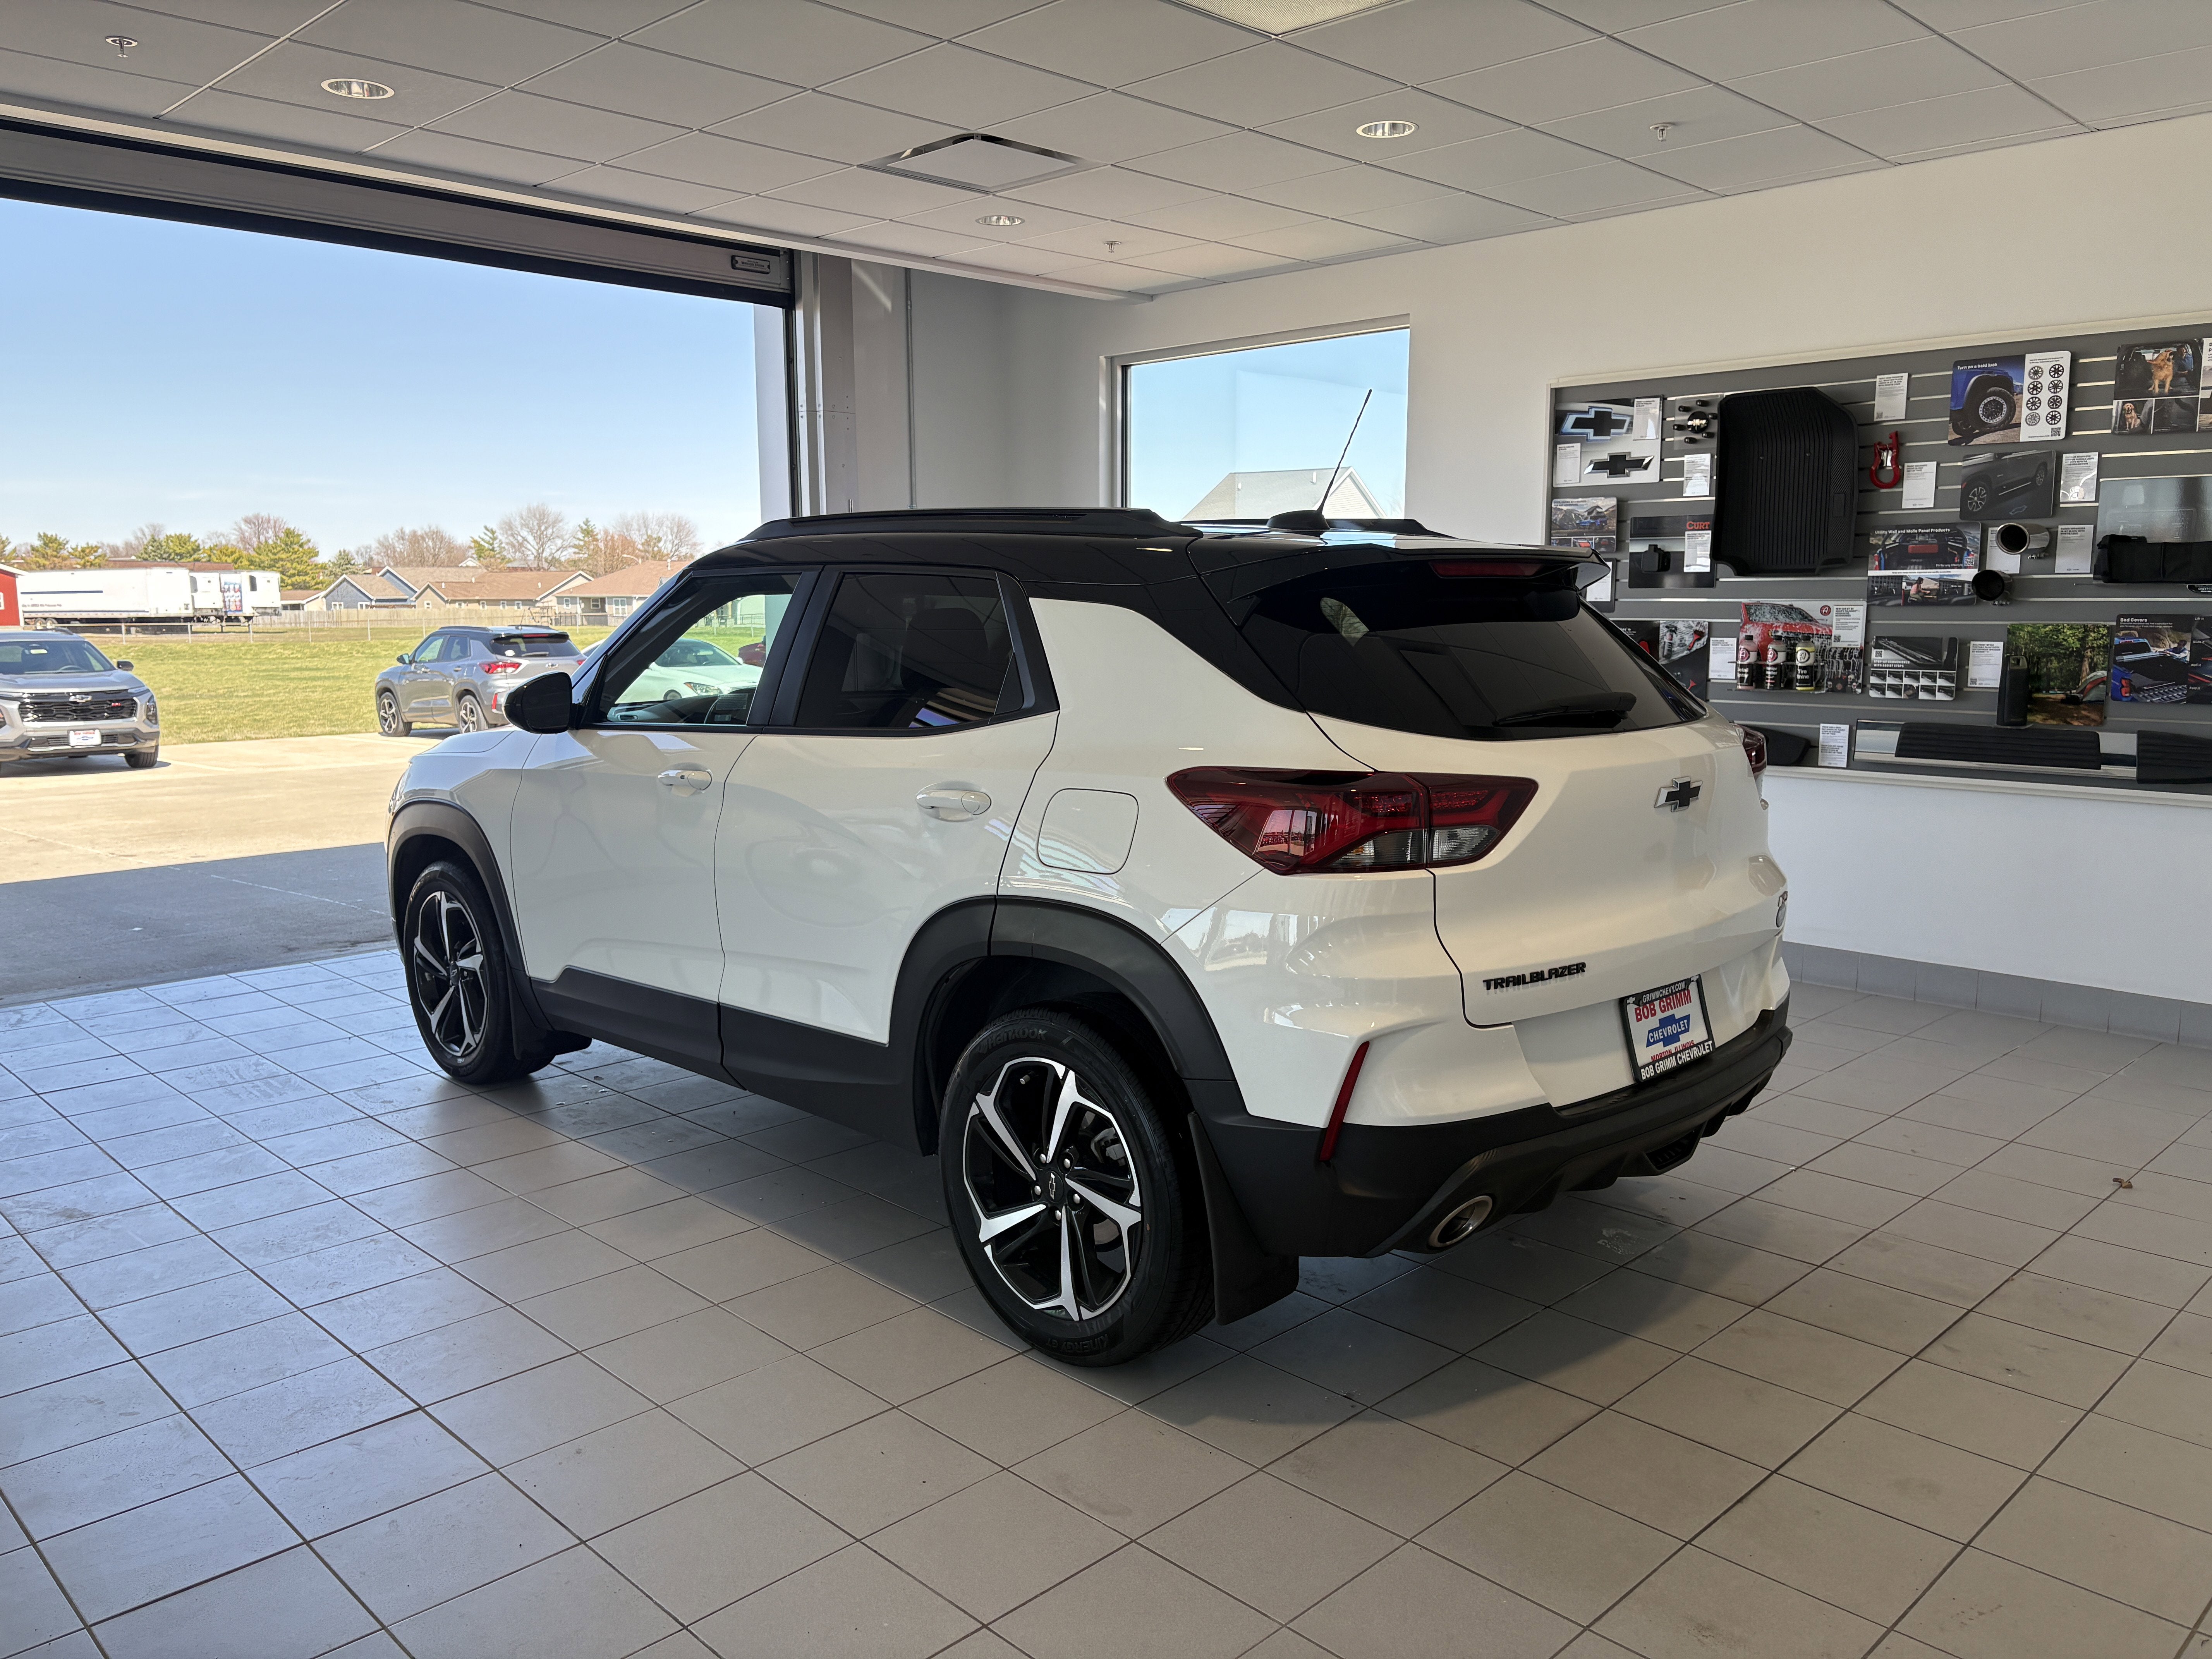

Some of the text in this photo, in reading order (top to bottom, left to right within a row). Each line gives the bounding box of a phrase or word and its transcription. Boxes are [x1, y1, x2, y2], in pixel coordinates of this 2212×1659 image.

[1686, 521, 1710, 530] CURT
[1483, 962, 1586, 990] TRAILBLAZER
[1642, 981, 1685, 1003] GRIMMCHEVY.COM
[1635, 989, 1692, 1022] BOB GRIMM
[1649, 1020, 1688, 1042] CHEVROLET
[1674, 1040, 1695, 1053] ILLINOIS
[1641, 1041, 1712, 1080] BOB GRIMM CHEVROLET
